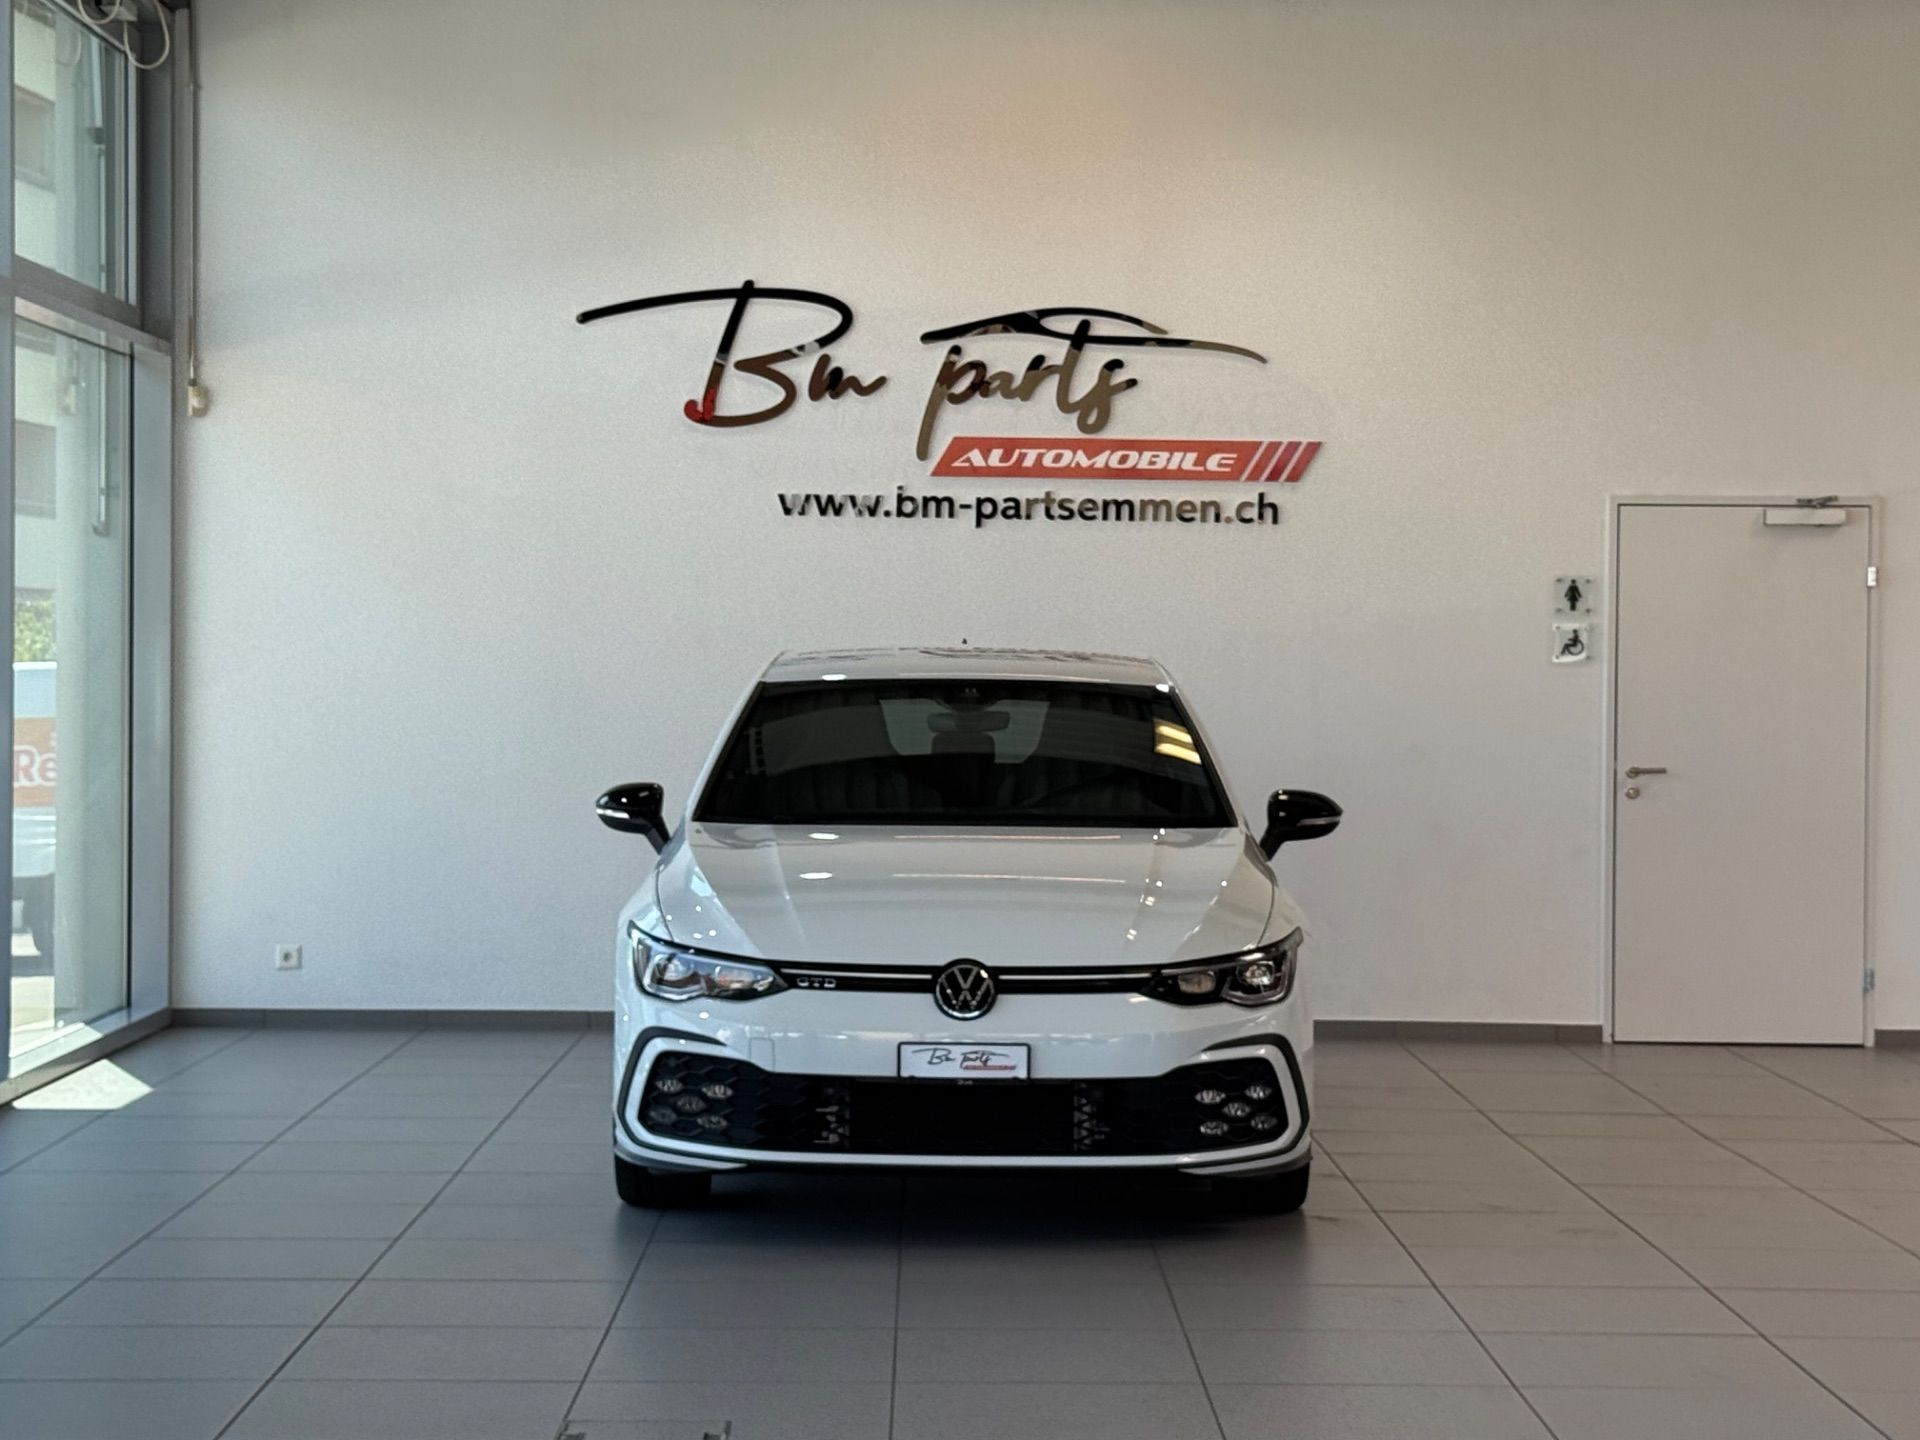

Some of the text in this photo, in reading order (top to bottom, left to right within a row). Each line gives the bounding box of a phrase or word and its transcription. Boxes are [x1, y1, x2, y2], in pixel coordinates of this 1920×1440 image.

[577, 280, 887, 428] Bm
[950, 448, 1238, 473] AUTOMOBILE
[778, 486, 1280, 528] www.bm-partsemmen.ch
[796, 976, 837, 988] GTD
